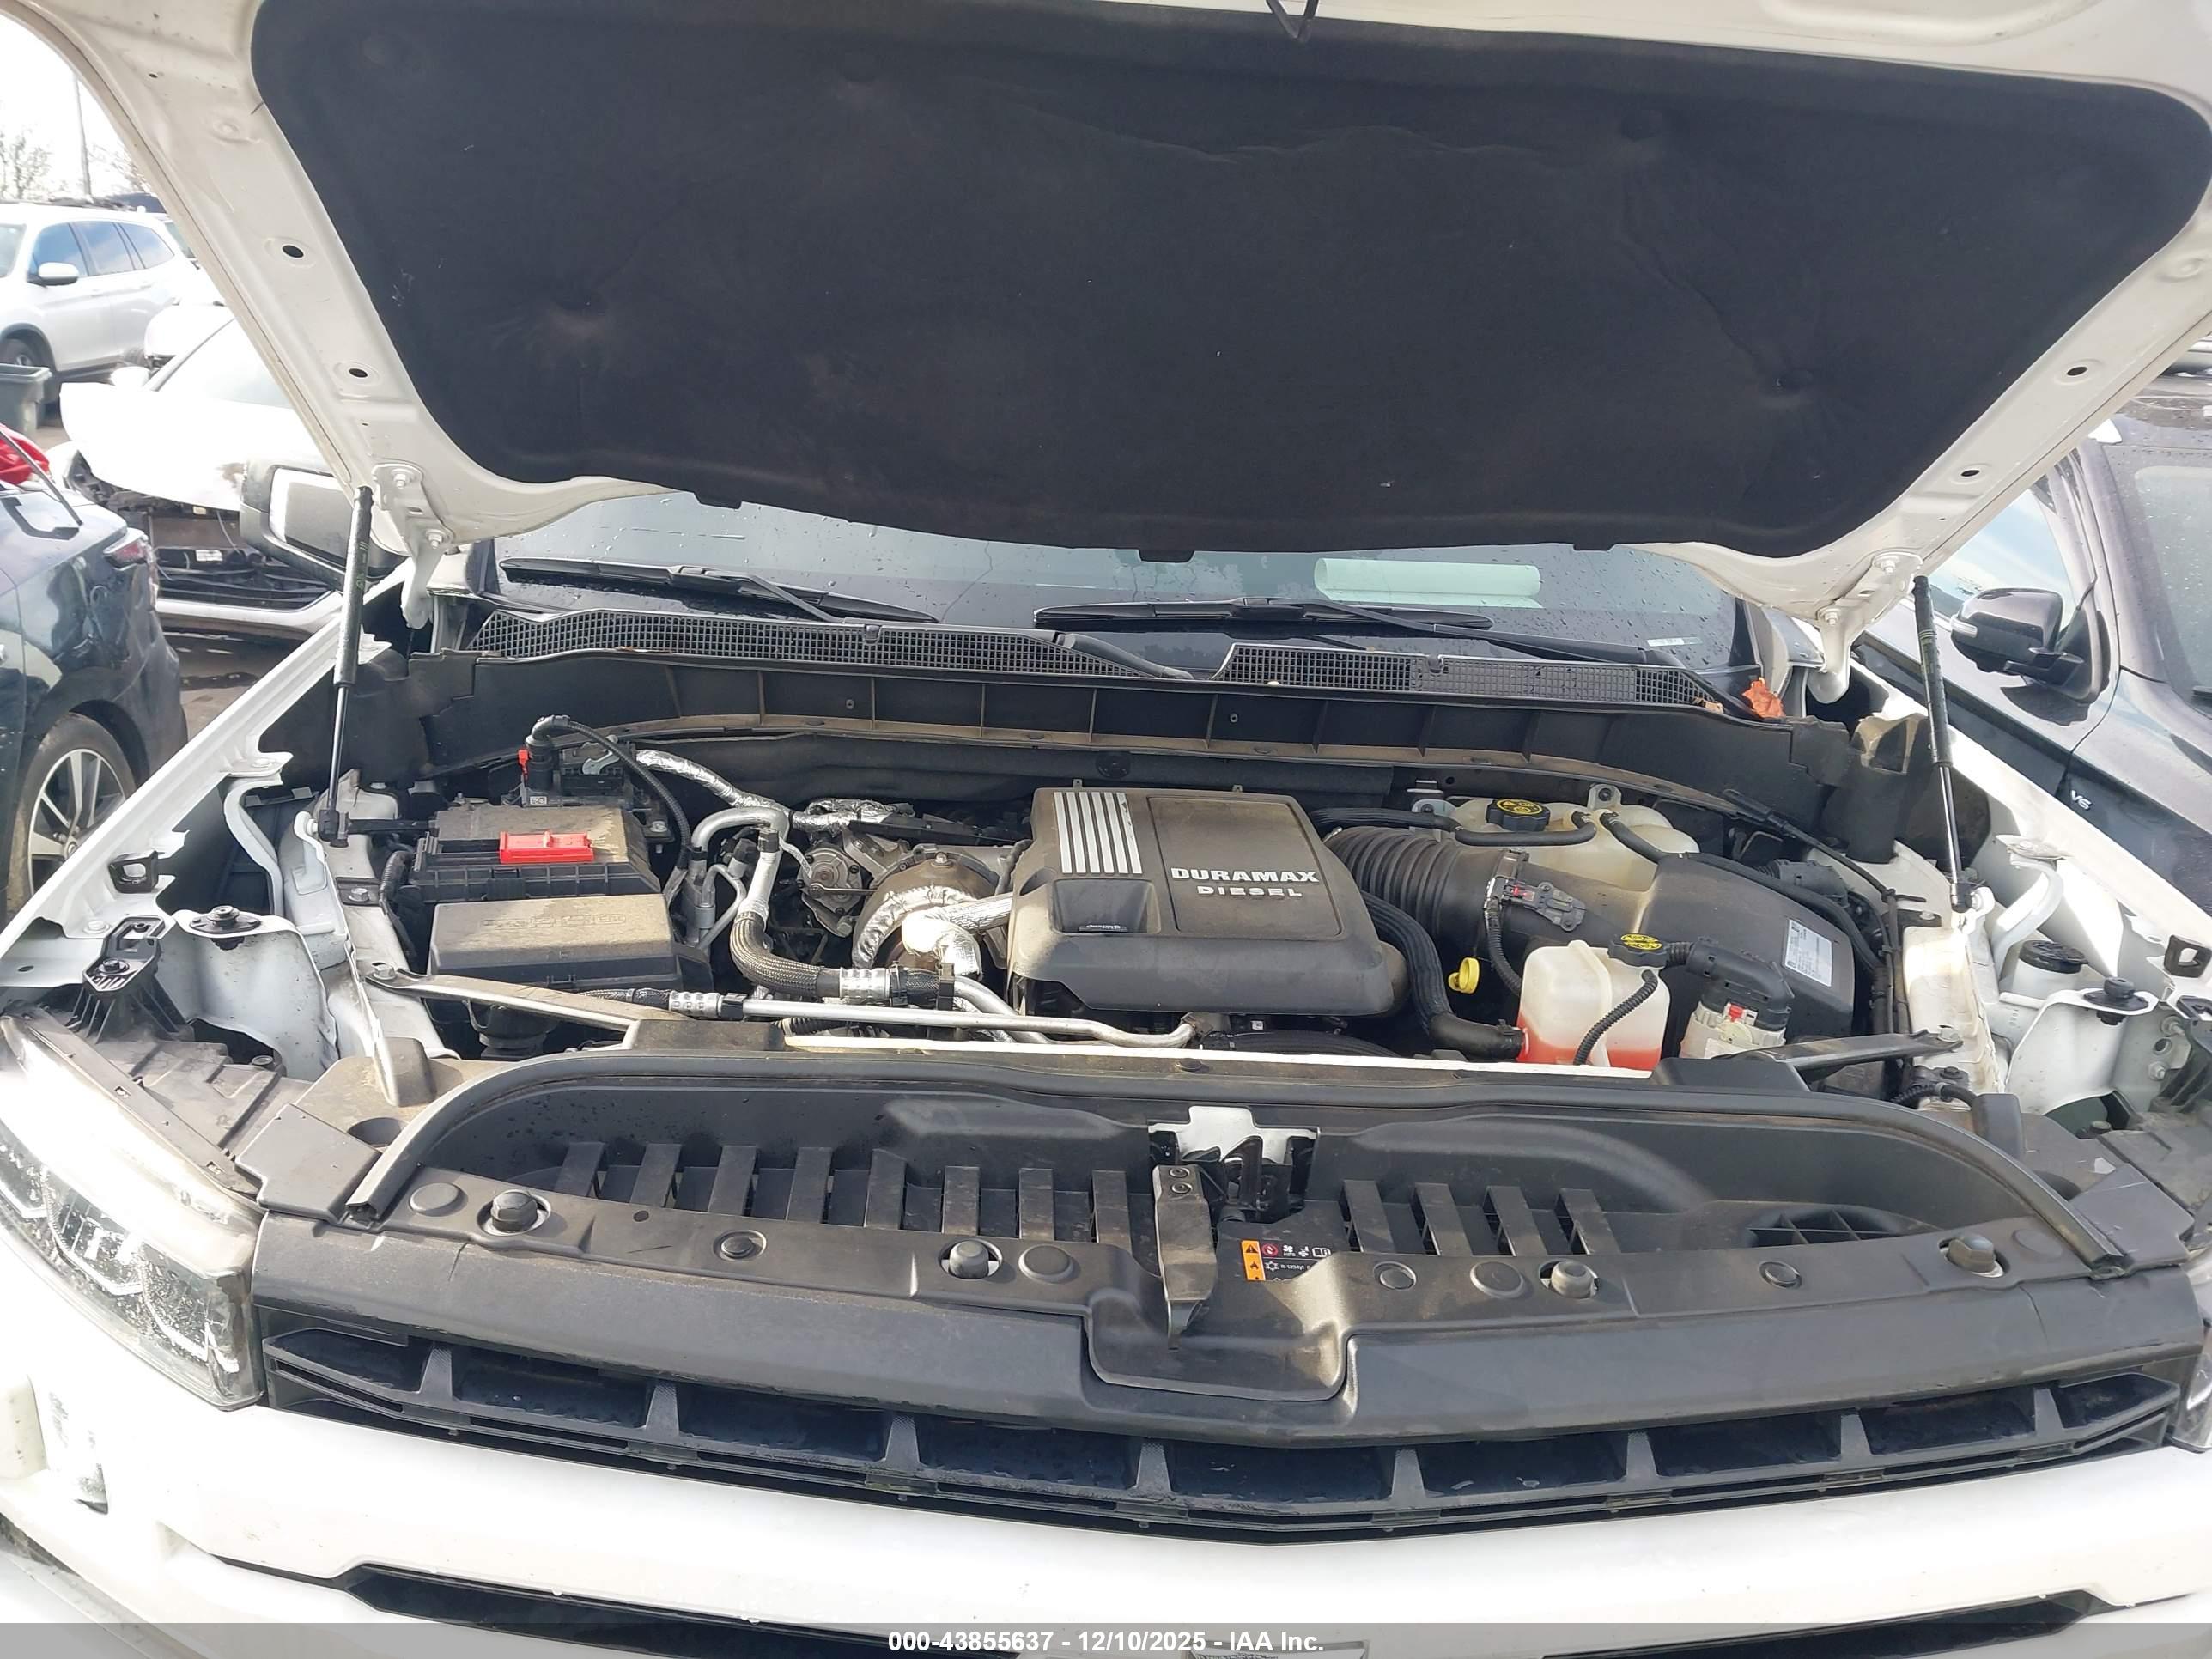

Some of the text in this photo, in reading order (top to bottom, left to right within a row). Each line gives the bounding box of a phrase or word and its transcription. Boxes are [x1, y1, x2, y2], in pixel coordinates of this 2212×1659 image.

[2069, 789, 2093, 810] V6
[1170, 867, 1320, 883] DURAMAX
[1196, 885, 1303, 897] DIESEL
